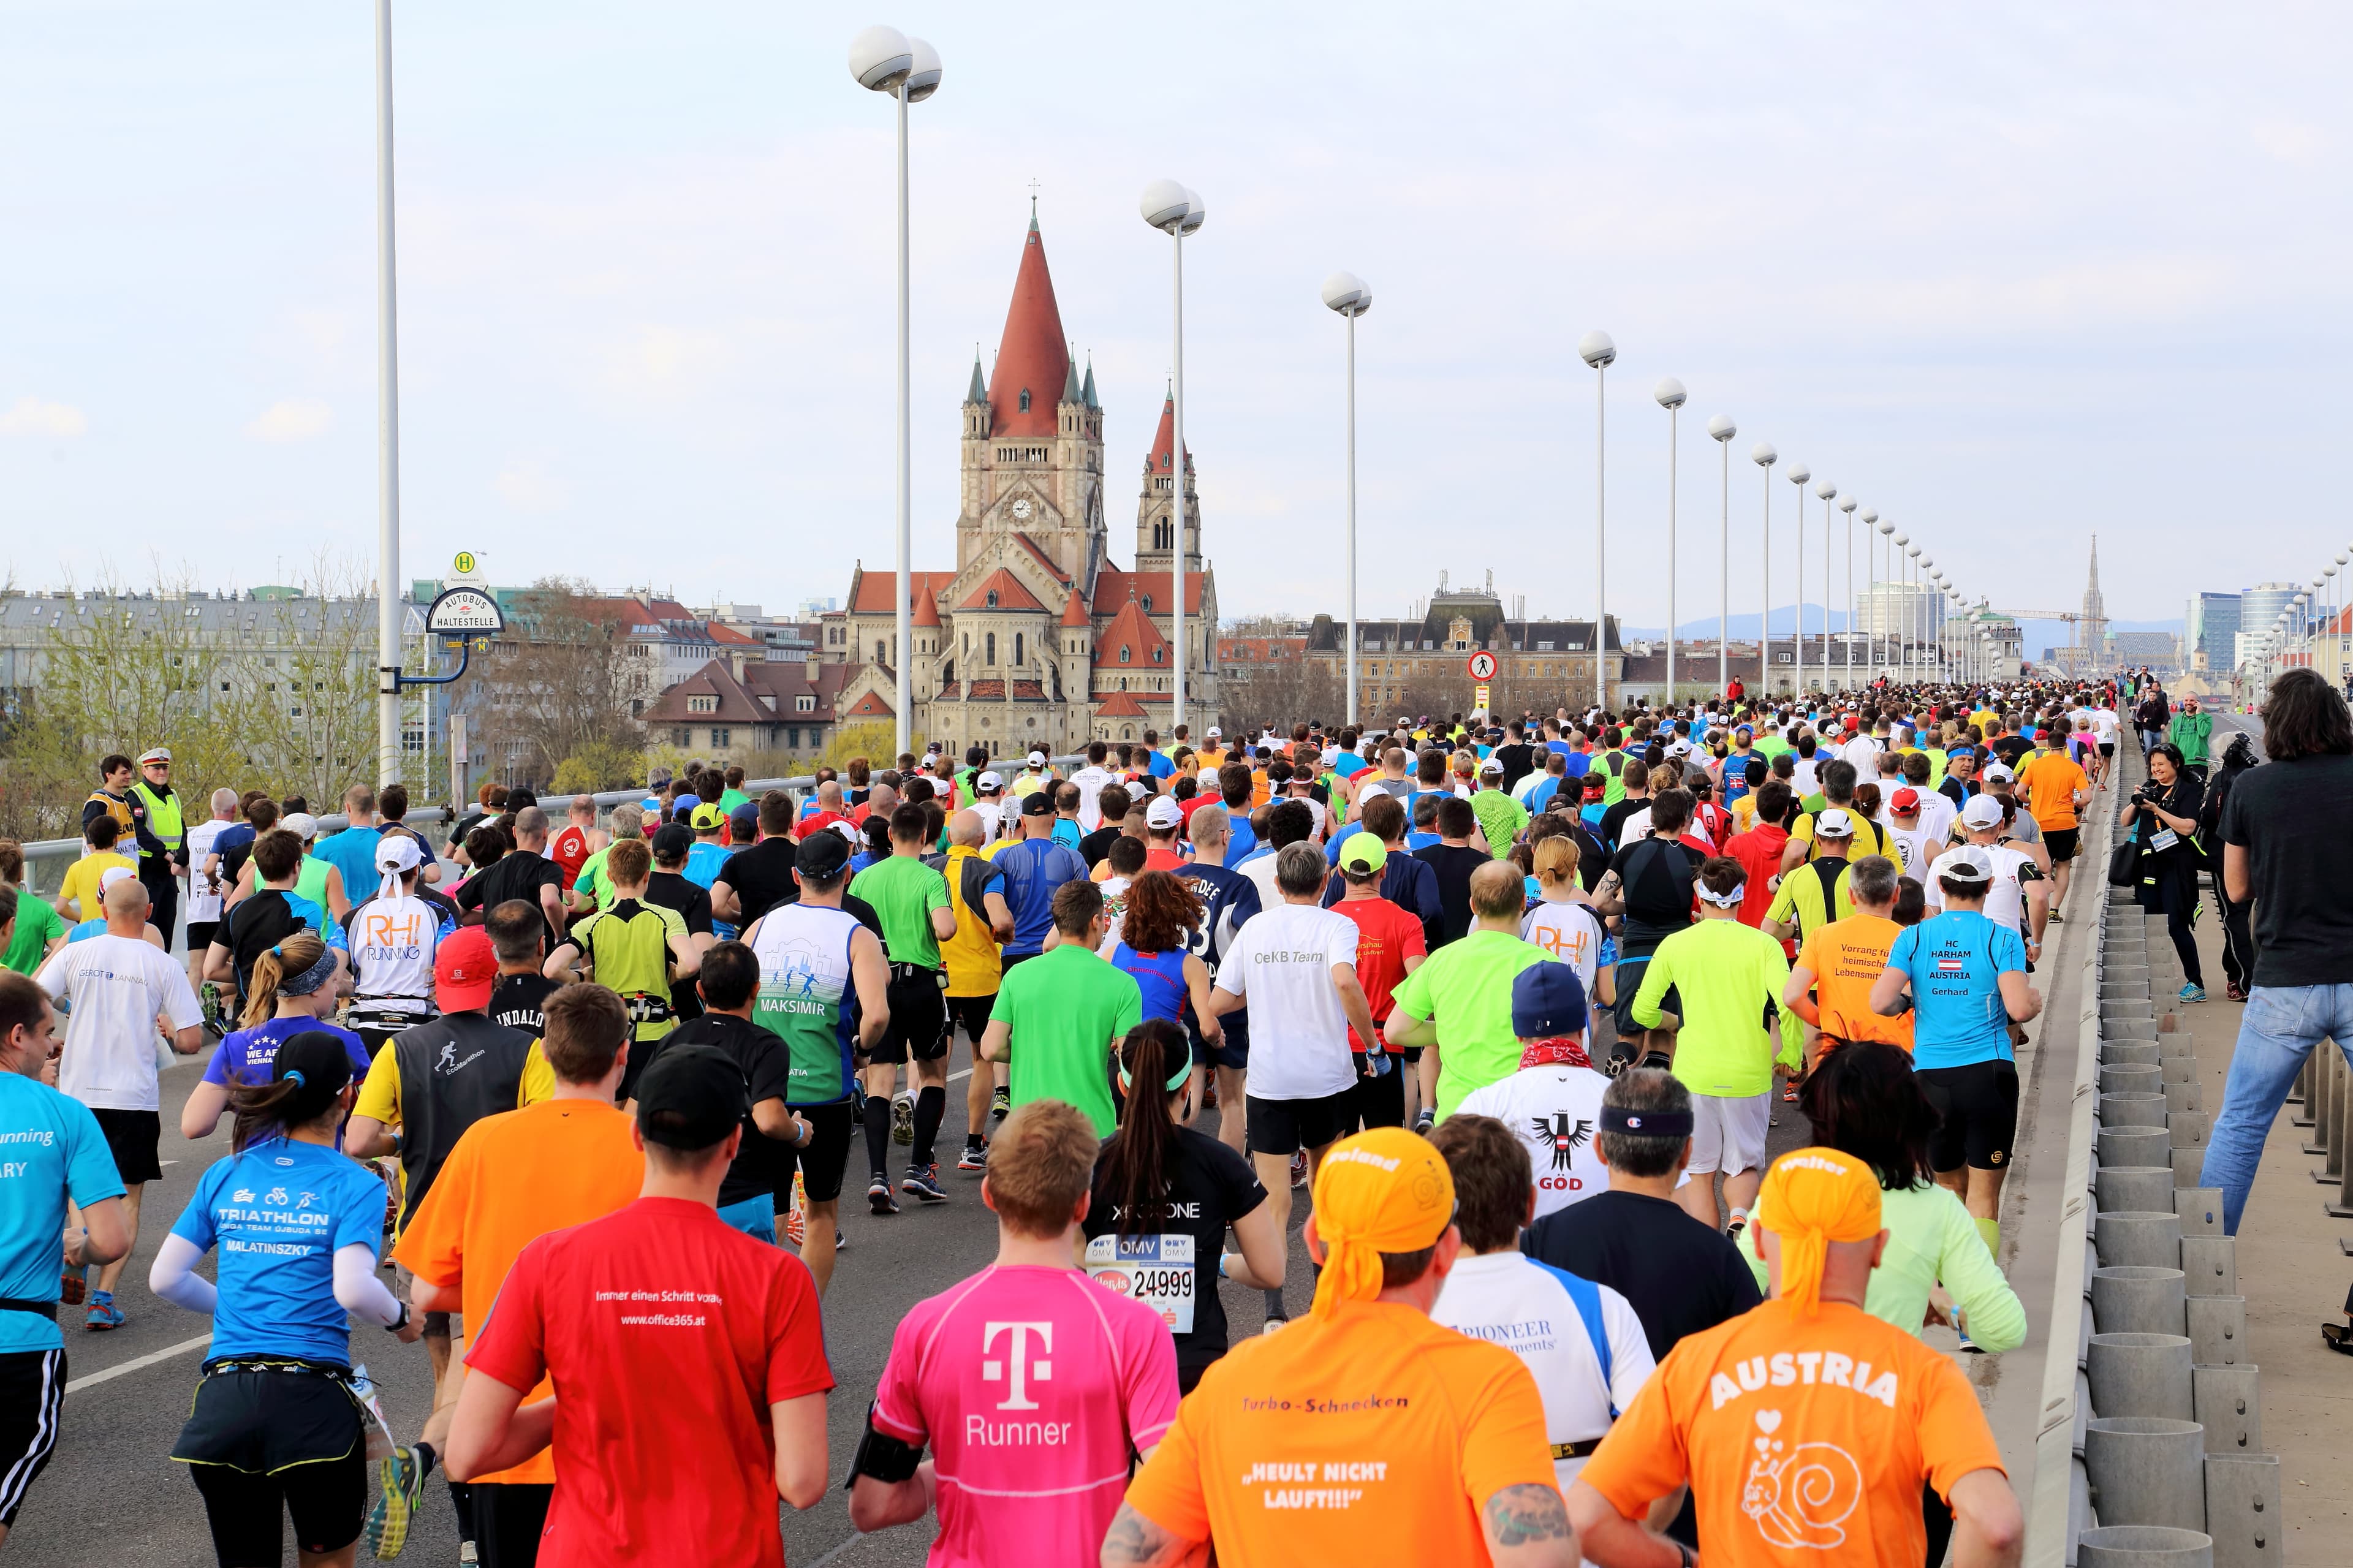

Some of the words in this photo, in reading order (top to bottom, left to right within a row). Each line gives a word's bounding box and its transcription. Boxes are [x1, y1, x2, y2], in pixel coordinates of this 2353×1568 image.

[460, 556, 469, 569] H
[445, 594, 487, 610] AUTOBUS
[438, 618, 494, 626] HALTESTELLE
[368, 946, 420, 961] RUNNING
[1255, 951, 1289, 964] OeKB
[1293, 951, 1323, 963] Team
[1841, 944, 1877, 956] Vorrang
[1843, 956, 1886, 969] heimische
[1930, 971, 1971, 980] AUSTRIA
[760, 999, 825, 1017] MAKSIMIR
[496, 1009, 544, 1028] INDALO
[246, 1050, 262, 1059] WE
[445, 1048, 485, 1076] EcoMarathon
[0, 1162, 28, 1178] RY
[1539, 1173, 1583, 1190] GÖD
[218, 1209, 329, 1225] TRIATHLON
[226, 1240, 311, 1256] MALATINSZKY
[1120, 1240, 1156, 1255] OMV
[1135, 1270, 1192, 1297] 24999
[596, 1290, 629, 1301] Immer
[631, 1289, 658, 1301] einen
[662, 1290, 694, 1302] Schritt
[621, 1314, 706, 1326] www.office365.at
[1463, 1320, 1552, 1341] PIONEER
[1711, 1351, 1898, 1411] AUSTRIA
[1242, 1393, 1409, 1413] Turbo-Schnecken
[966, 1414, 1071, 1446] Runner
[1324, 1462, 1387, 1482] NICHT
